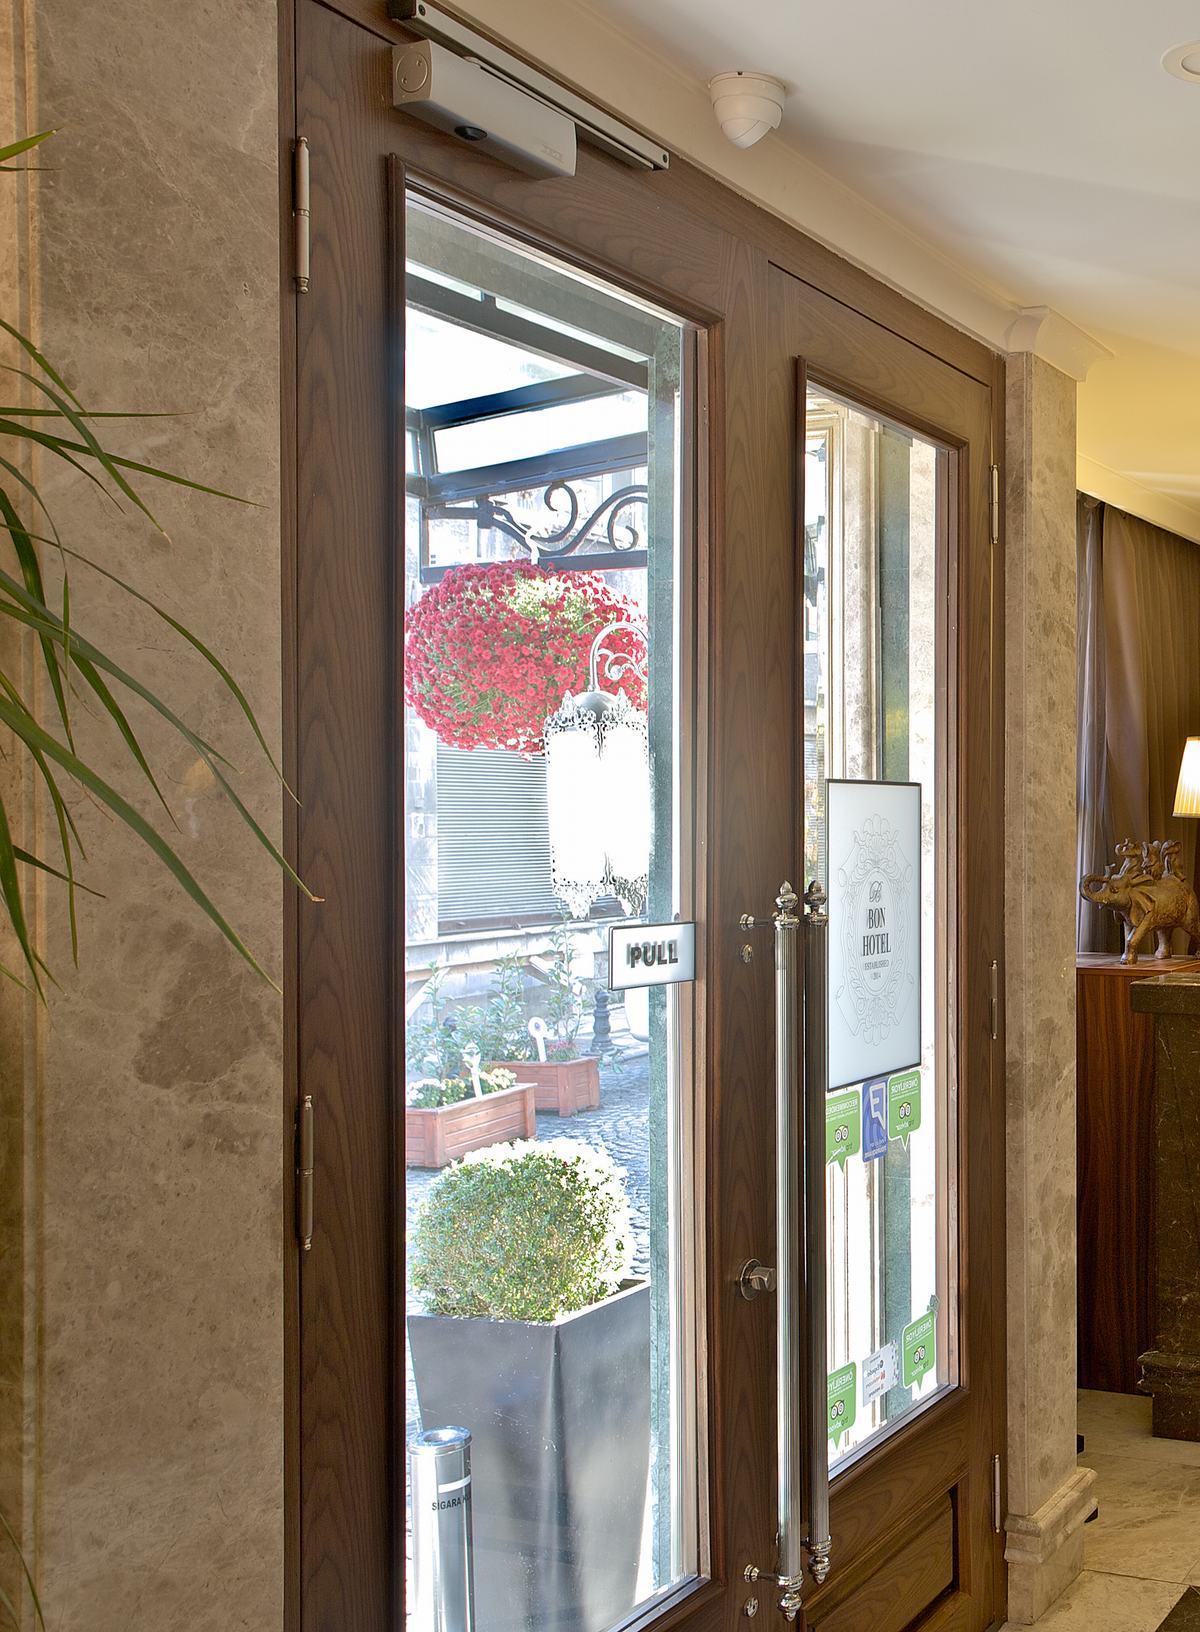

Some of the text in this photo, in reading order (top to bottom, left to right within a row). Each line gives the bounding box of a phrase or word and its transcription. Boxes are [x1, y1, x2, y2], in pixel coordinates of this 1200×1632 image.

[868, 907, 886, 930] BON
[630, 943, 678, 969] PULL
[862, 933, 891, 957] HOTEL
[864, 960, 889, 970] ESTABLISHED
